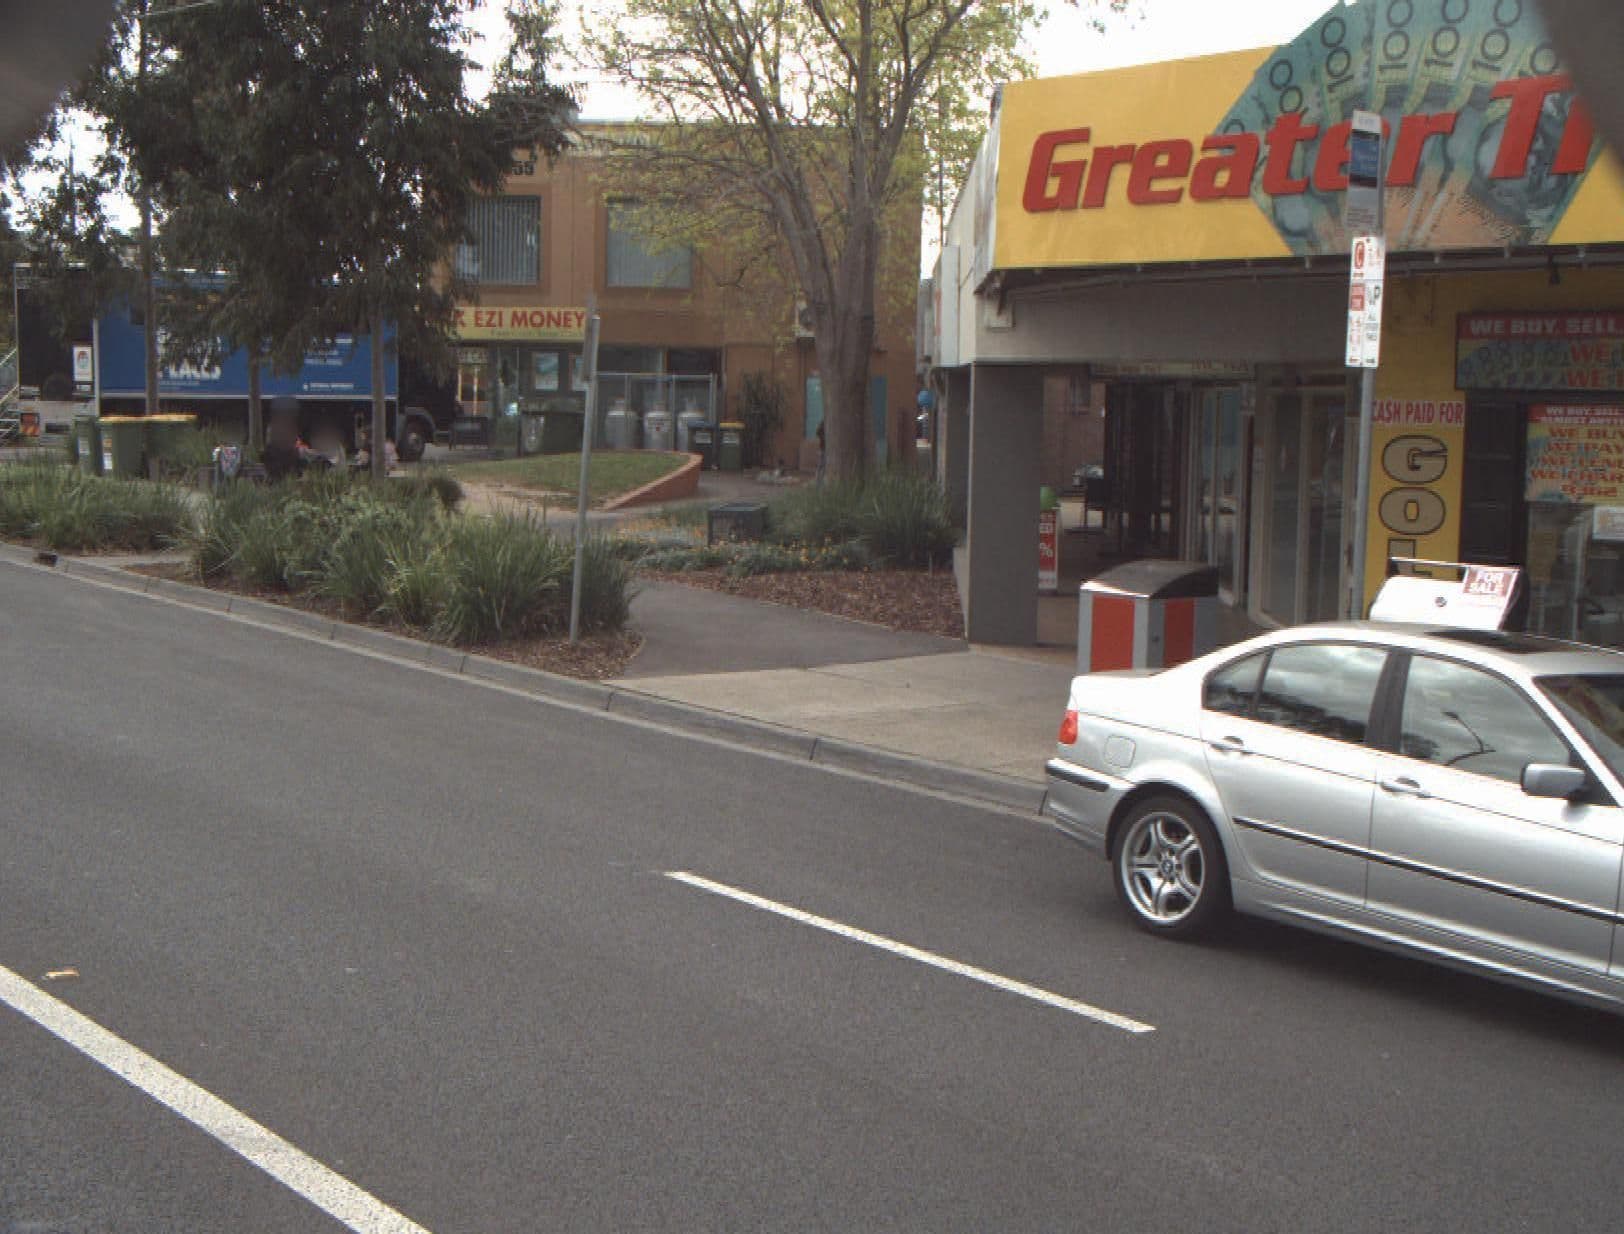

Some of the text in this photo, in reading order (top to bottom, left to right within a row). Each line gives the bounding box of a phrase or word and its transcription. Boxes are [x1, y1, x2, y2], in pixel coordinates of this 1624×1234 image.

[1022, 111, 1459, 213] Greater
[474, 310, 503, 328] EZI
[510, 310, 585, 328] MONEY
[1470, 318, 1505, 335] WE
[1405, 400, 1434, 424] PAID
[1439, 401, 1464, 424] FOR
[1377, 433, 1449, 579] GOL
